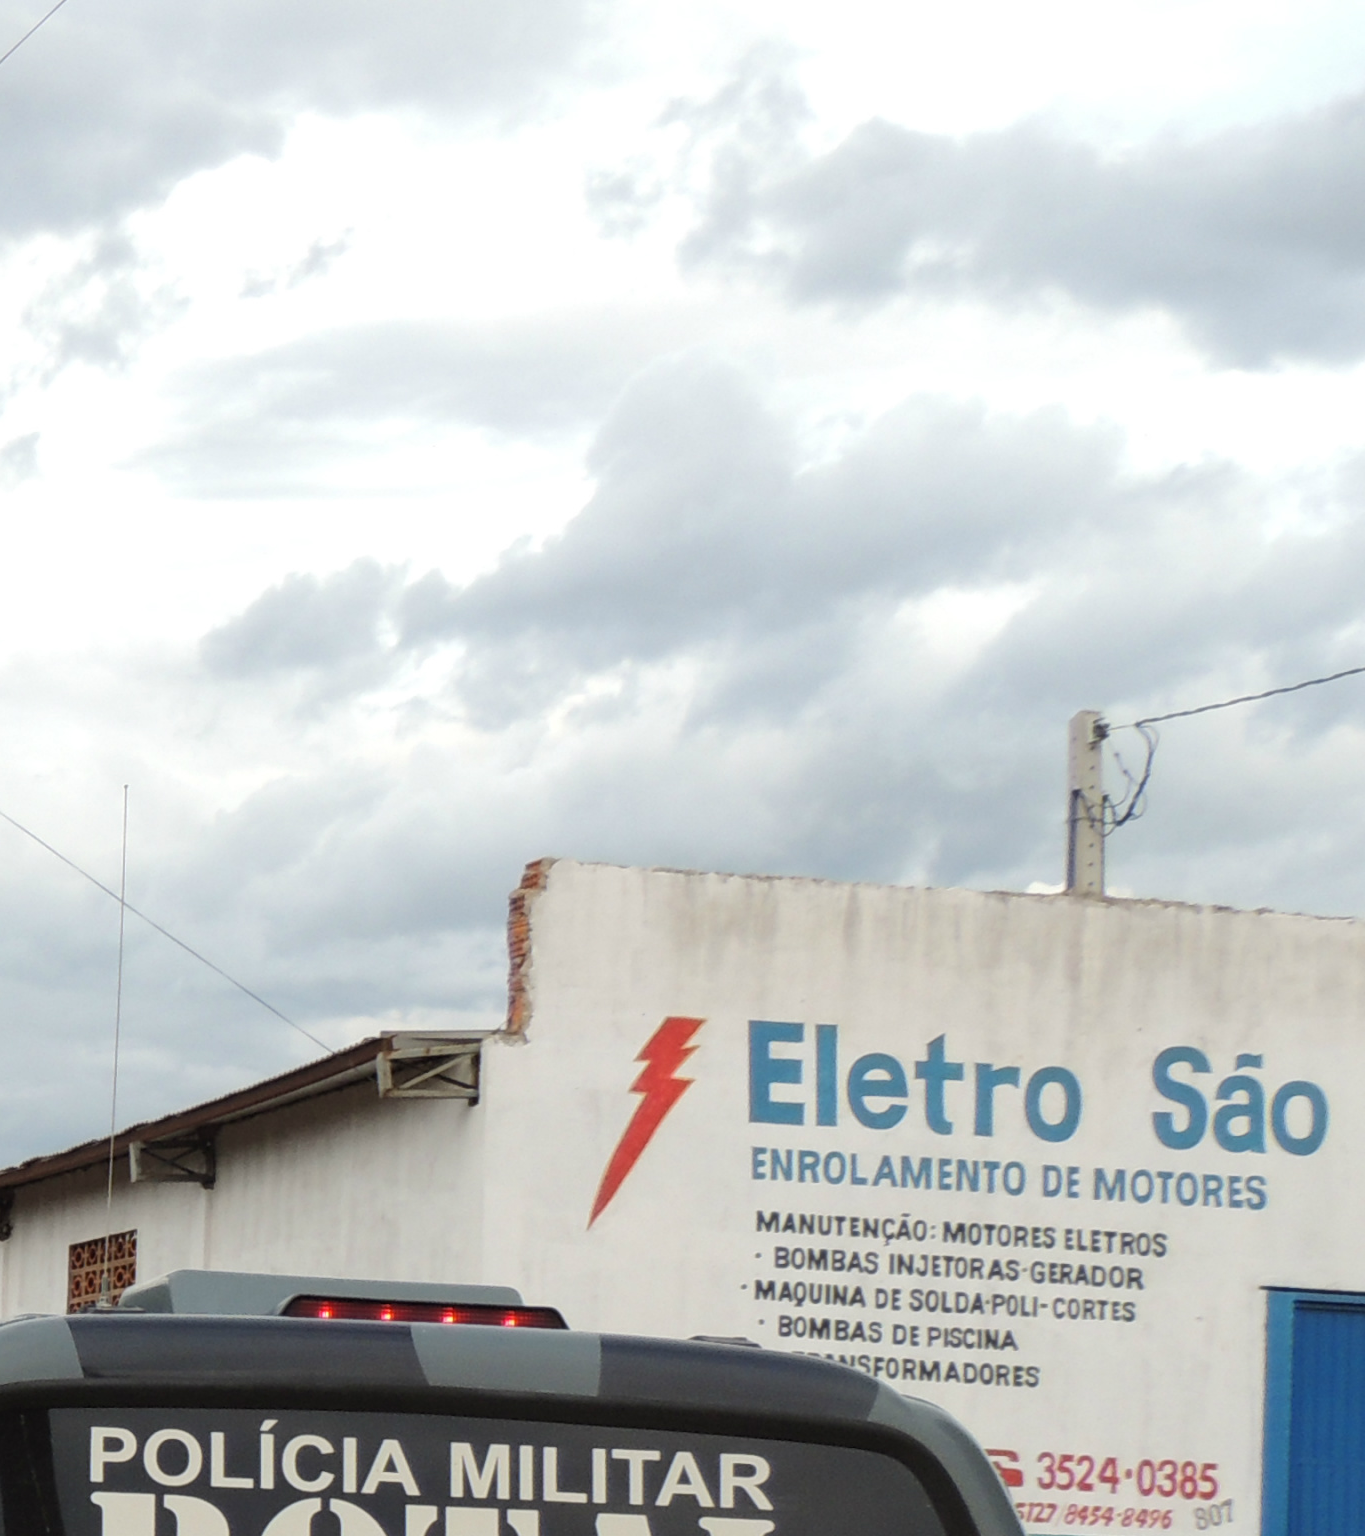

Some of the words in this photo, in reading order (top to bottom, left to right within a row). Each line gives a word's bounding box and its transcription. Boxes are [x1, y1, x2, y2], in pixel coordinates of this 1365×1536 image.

[747, 1019, 1083, 1143] Eletro
[1151, 1045, 1330, 1156] São
[751, 1146, 1027, 1196] ENROLAMENTO
[1042, 1165, 1080, 1199] DE
[1094, 1167, 1267, 1210] MOTORES
[756, 1210, 937, 1246] MANUTENÇÃO:
[942, 1221, 1056, 1249] MOTORES
[1064, 1229, 1168, 1258] ELETROS
[774, 1246, 879, 1275] BOMBAS
[754, 1280, 866, 1309] MAQUINA
[874, 1287, 901, 1311] DE
[778, 1315, 883, 1345] BOMBAS
[892, 1323, 920, 1346] DE
[926, 1327, 1019, 1351] PISCINA
[790, 1351, 1041, 1388] SFORMADORES
[88, 1418, 421, 1497] POLÍCIA
[449, 1442, 774, 1511] MILITAR
